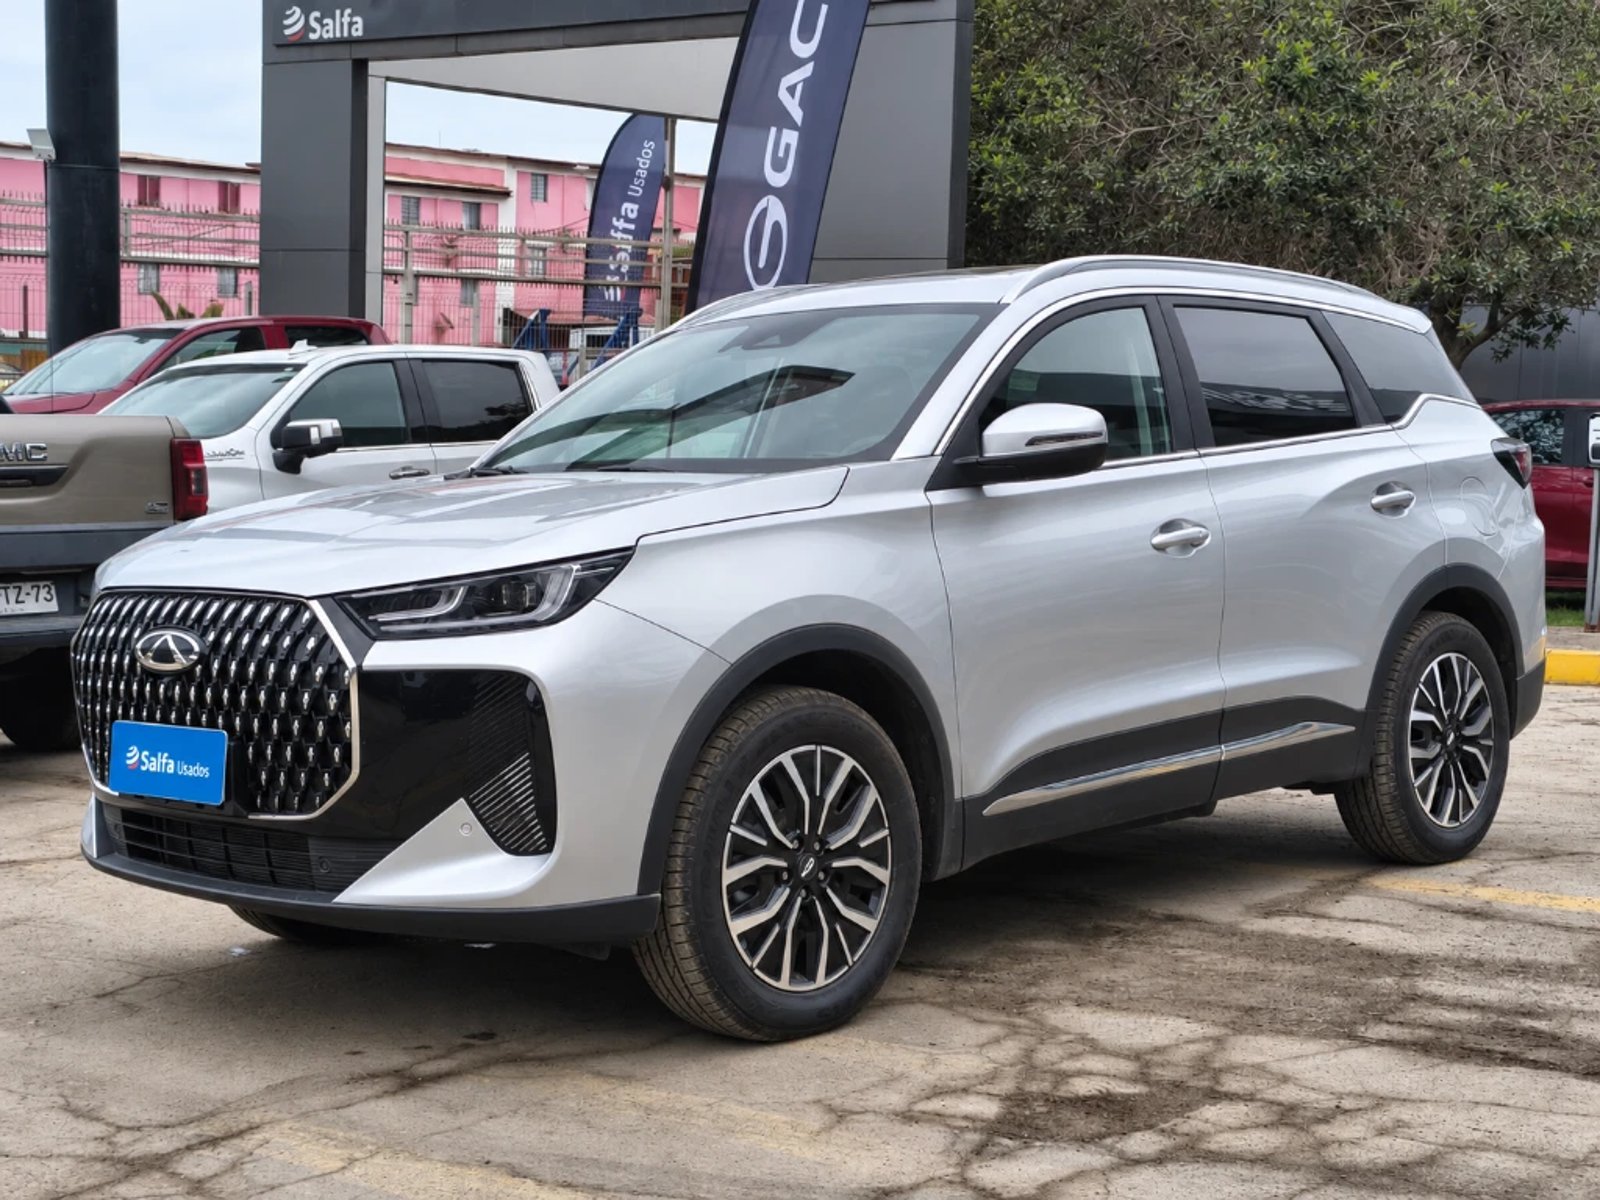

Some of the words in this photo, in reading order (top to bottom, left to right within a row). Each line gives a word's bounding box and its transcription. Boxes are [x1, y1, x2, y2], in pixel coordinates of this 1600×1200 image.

[308, 8, 364, 40] Salfa
[763, 0, 829, 188] GAC
[627, 139, 656, 197] Usados
[140, 750, 175, 774] Salfa
[177, 760, 210, 778] Usados
